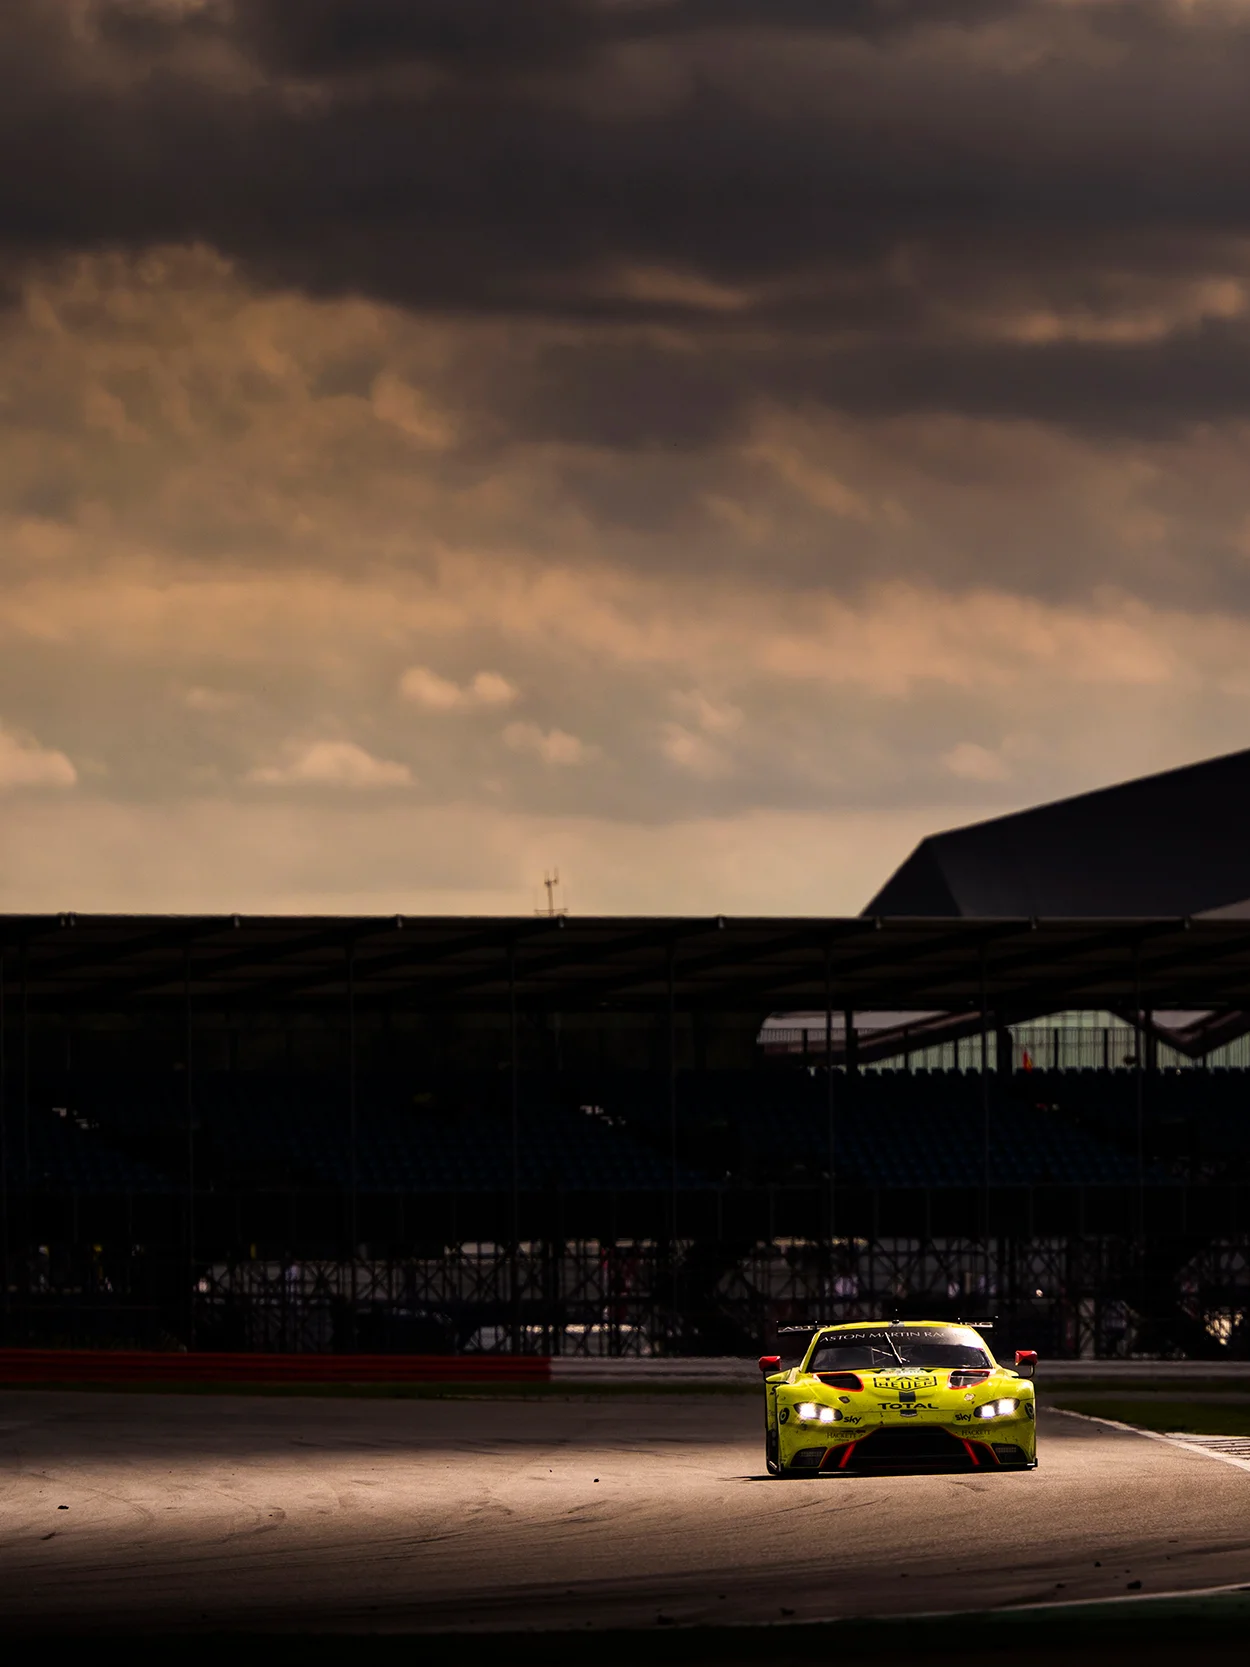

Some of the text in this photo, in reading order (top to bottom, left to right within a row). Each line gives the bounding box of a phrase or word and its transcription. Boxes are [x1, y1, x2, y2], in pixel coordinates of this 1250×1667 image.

[819, 1333, 866, 1343] ASTON
[868, 1331, 921, 1339] MARTIN
[879, 1381, 933, 1390] HEUER
[877, 1402, 939, 1410] TOTAL
[843, 1415, 862, 1425] sky
[954, 1413, 972, 1422] sky
